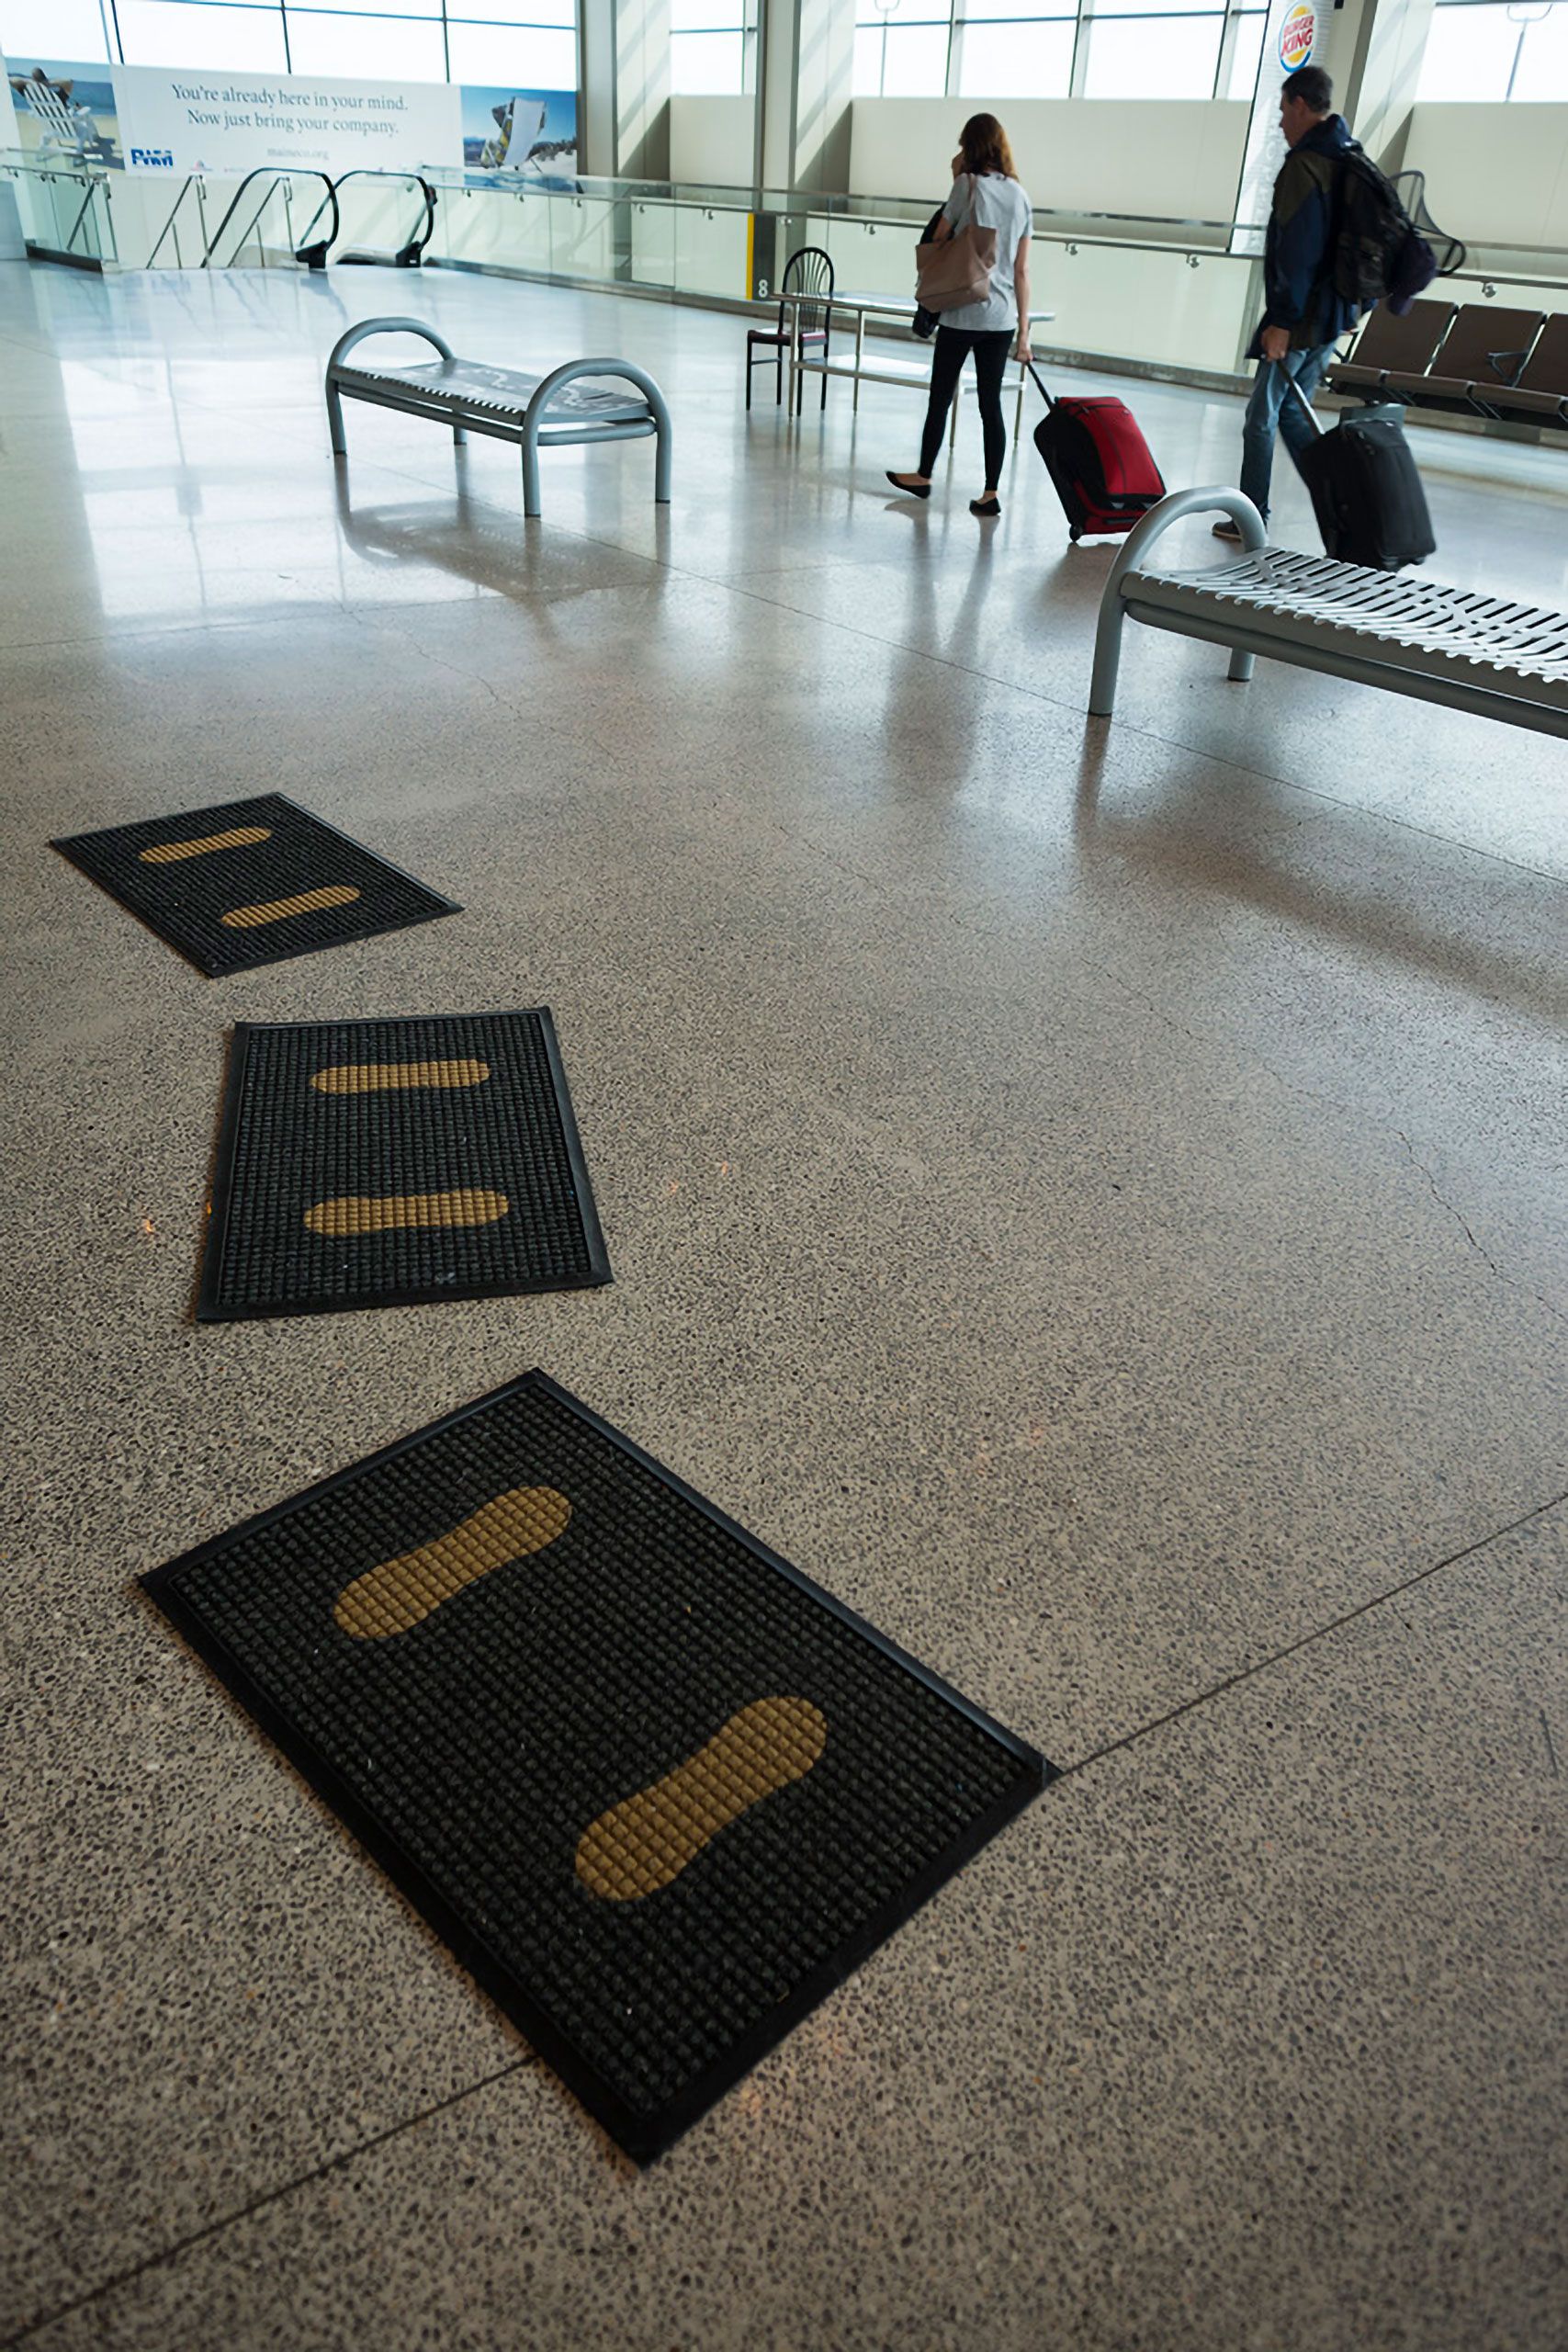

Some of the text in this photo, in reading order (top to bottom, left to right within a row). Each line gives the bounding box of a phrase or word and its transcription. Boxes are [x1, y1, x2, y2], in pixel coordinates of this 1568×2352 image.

[1280, 28, 1314, 57] KING
[172, 84, 409, 112] You're already here in your mind.
[187, 108, 400, 138] Now just bring your company.
[759, 278, 768, 298] 8
